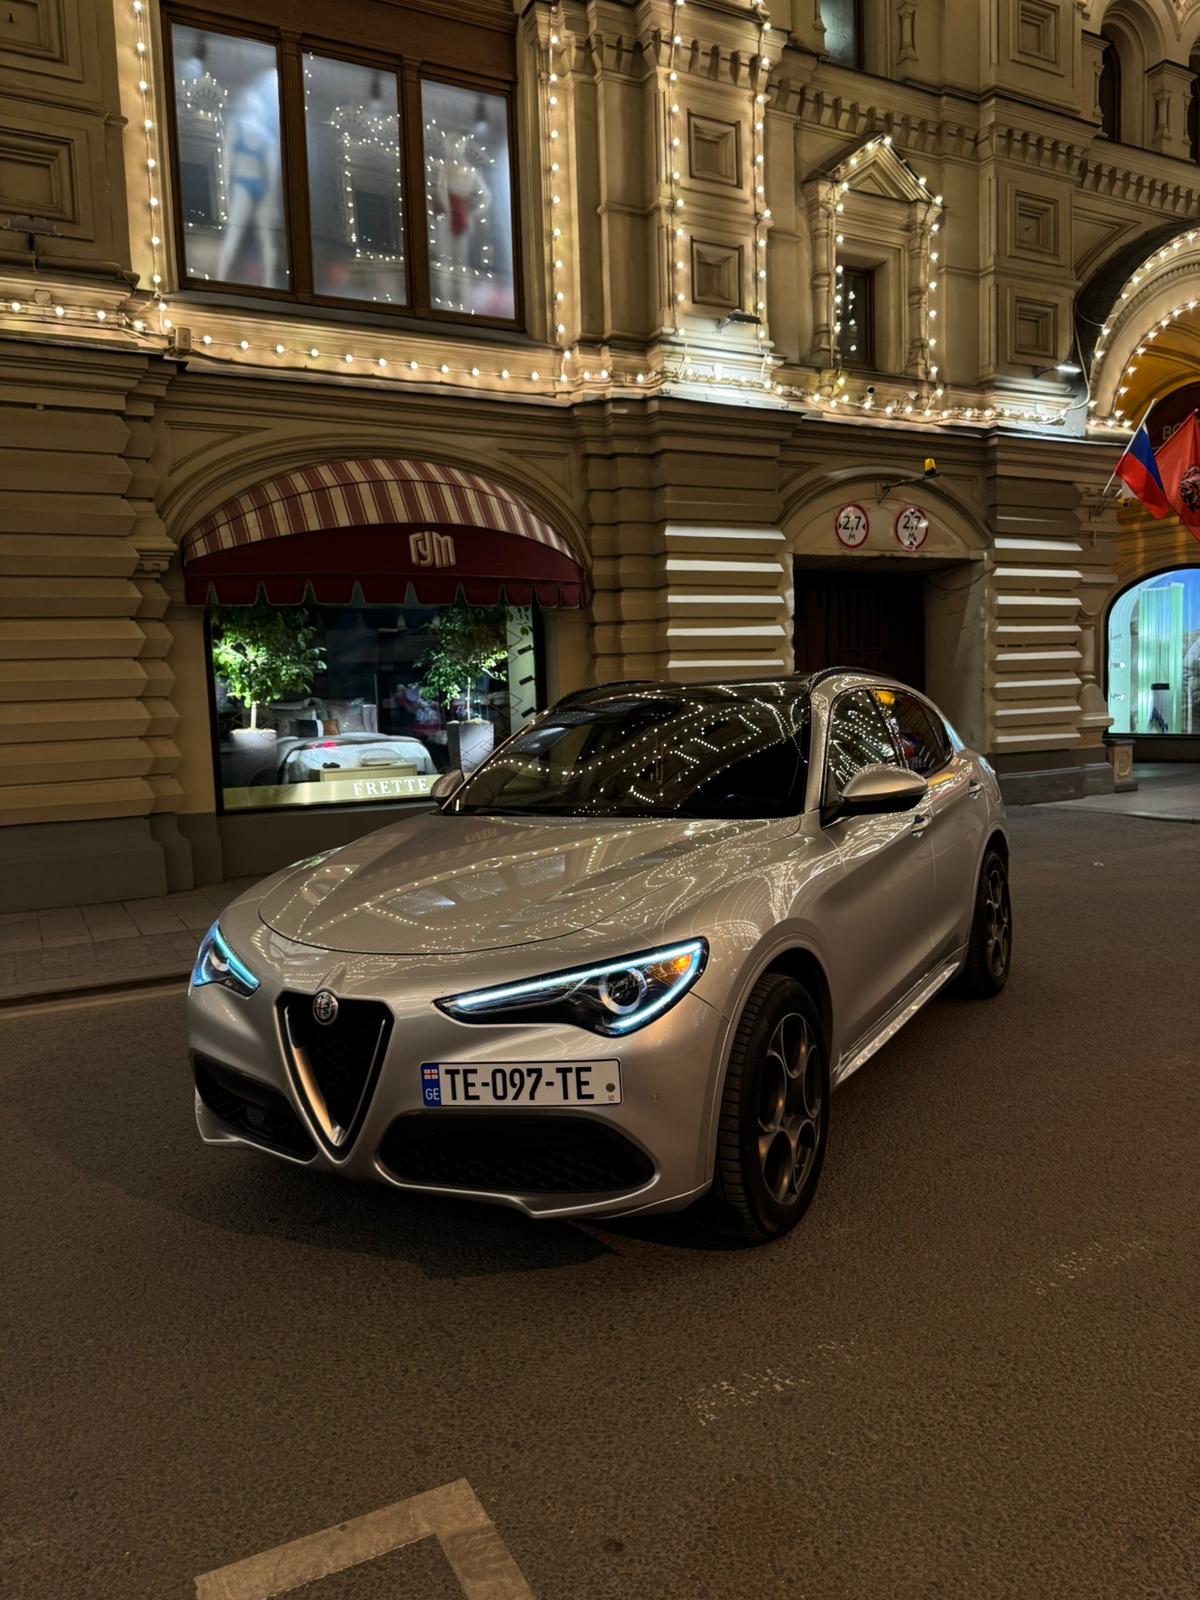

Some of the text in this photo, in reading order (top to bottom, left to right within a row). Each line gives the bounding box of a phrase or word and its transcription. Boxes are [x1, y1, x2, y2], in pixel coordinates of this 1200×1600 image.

[842, 515, 862, 533] 2,7
[902, 515, 921, 533] 2,7
[352, 778, 430, 796] FRETTE
[444, 1066, 595, 1101] TE-097-TE
[425, 1088, 440, 1101] GE
